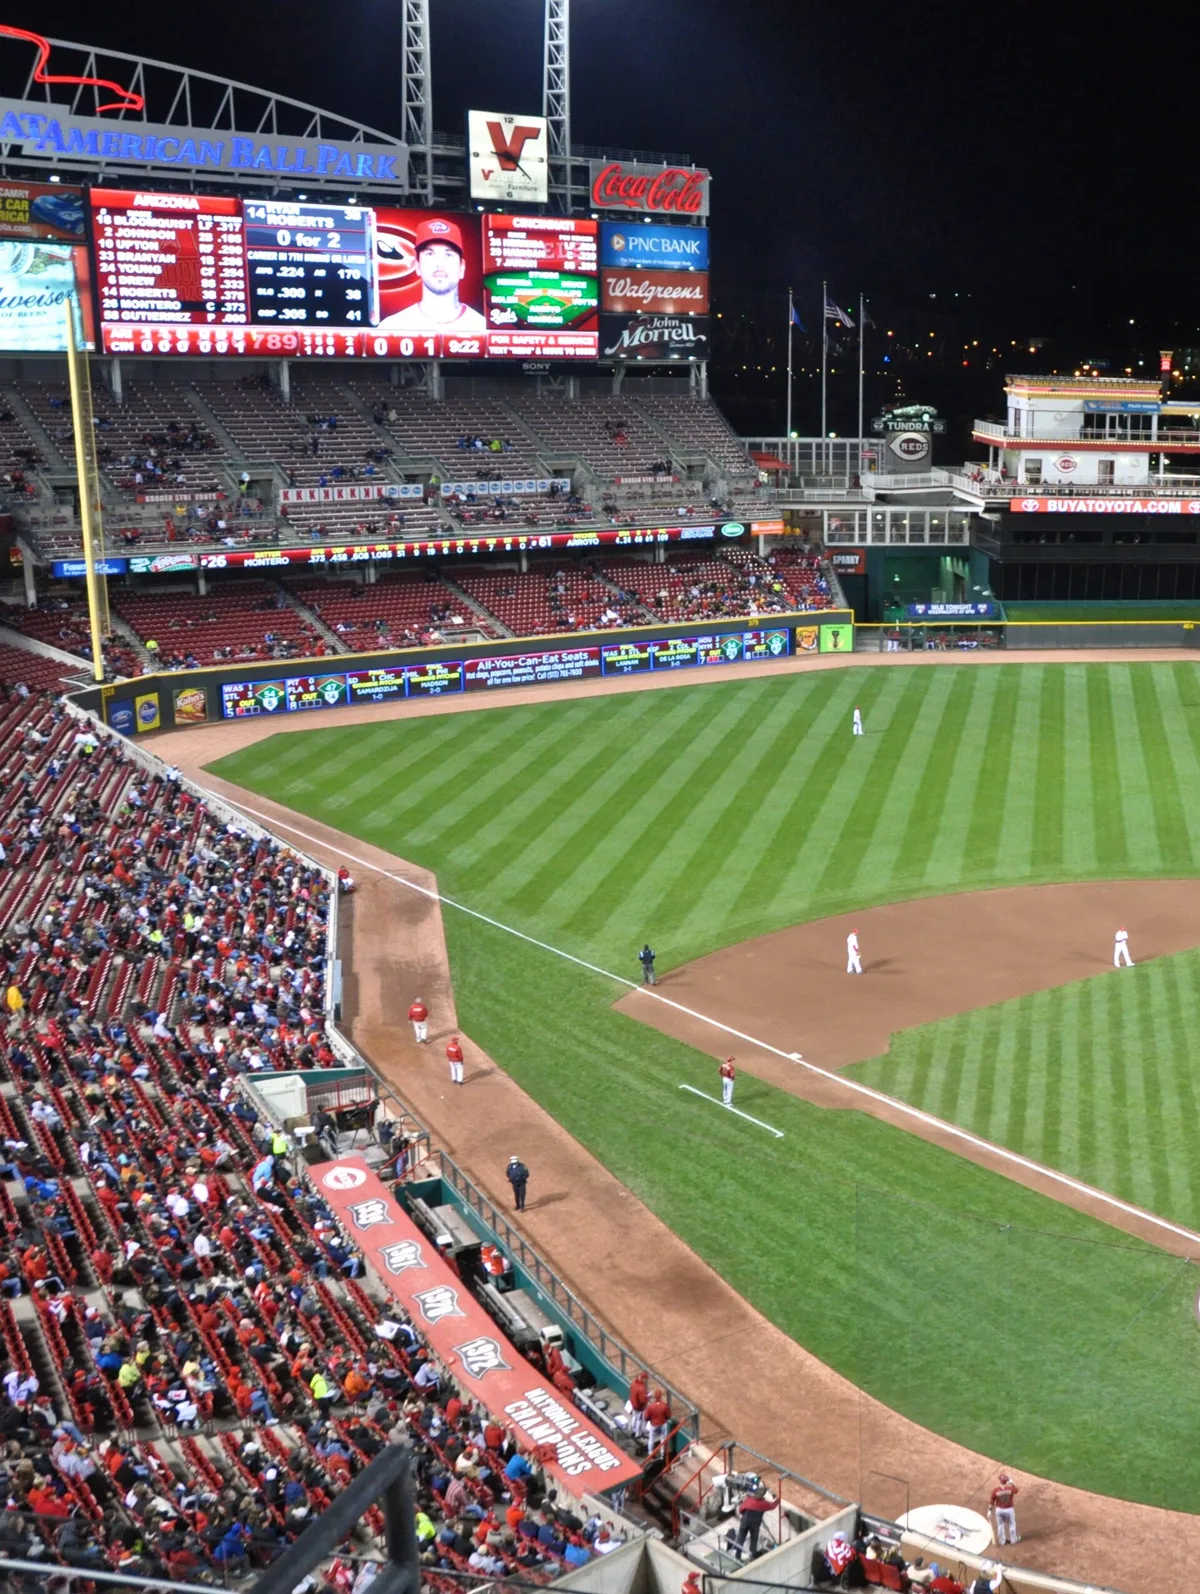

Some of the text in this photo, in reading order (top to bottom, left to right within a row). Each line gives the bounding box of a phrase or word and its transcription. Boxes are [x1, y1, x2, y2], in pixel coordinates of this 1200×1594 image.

[503, 116, 514, 124] 12
[35, 119, 397, 179] AMERICAN BALL PARK
[507, 183, 538, 192] Furniture
[592, 163, 708, 213] Coca-Cola
[506, 191, 513, 199] 6
[5, 199, 29, 210] CAR
[133, 194, 200, 210] ARIZONA
[247, 207, 266, 219] 14
[114, 215, 194, 229] BLOOMQUIST
[198, 221, 213, 230] LF
[217, 223, 242, 232] .317
[267, 214, 335, 228] ROBERTS
[115, 227, 176, 240] JOHNSON
[277, 229, 341, 248] 0 for 2
[116, 239, 160, 251] UPTON
[628, 236, 701, 255] PNC BANK
[117, 251, 176, 263] BRANYAN
[117, 263, 162, 275] YOUNG
[276, 266, 361, 280] .224 170
[118, 275, 155, 286] DREW
[119, 287, 177, 299] ROBERTS
[606, 277, 704, 304] Walgreens
[120, 299, 182, 310] MONTERO
[121, 311, 192, 322] GUTIERREZ
[346, 310, 361, 321] 41
[647, 316, 680, 328] John
[604, 323, 707, 355] Morrell
[449, 340, 479, 353] 9:22
[522, 362, 551, 370] SONY
[886, 421, 930, 432] TUNDRA
[901, 442, 929, 451] REDS
[283, 487, 383, 500] K K K K K K
[1048, 500, 1181, 514] BUYATOYOTA.COM
[567, 538, 599, 547] ARROYO
[308, 555, 326, 563] .373
[371, 551, 392, 559] 1.065
[427, 548, 435, 556] 19
[832, 555, 860, 565] SPARKY
[244, 557, 289, 567] MONTERO
[477, 651, 589, 671] All-You-Can-Eat Seats
[535, 665, 551, 673] potato
[552, 663, 564, 671] chips
[584, 659, 599, 667] drinks
[421, 680, 448, 688] MADSON
[511, 675, 521, 683] low
[223, 684, 244, 694] WAS
[288, 686, 303, 694] FLA
[356, 686, 398, 695] SAMARDZIJA
[176, 692, 205, 708] Kahn's
[239, 699, 256, 707] OUT
[385, 1242, 417, 1268] 1961
[420, 1287, 453, 1317] 1970
[460, 1339, 499, 1372] 1972
[524, 1387, 621, 1471] NATIONAL LEAGUE
